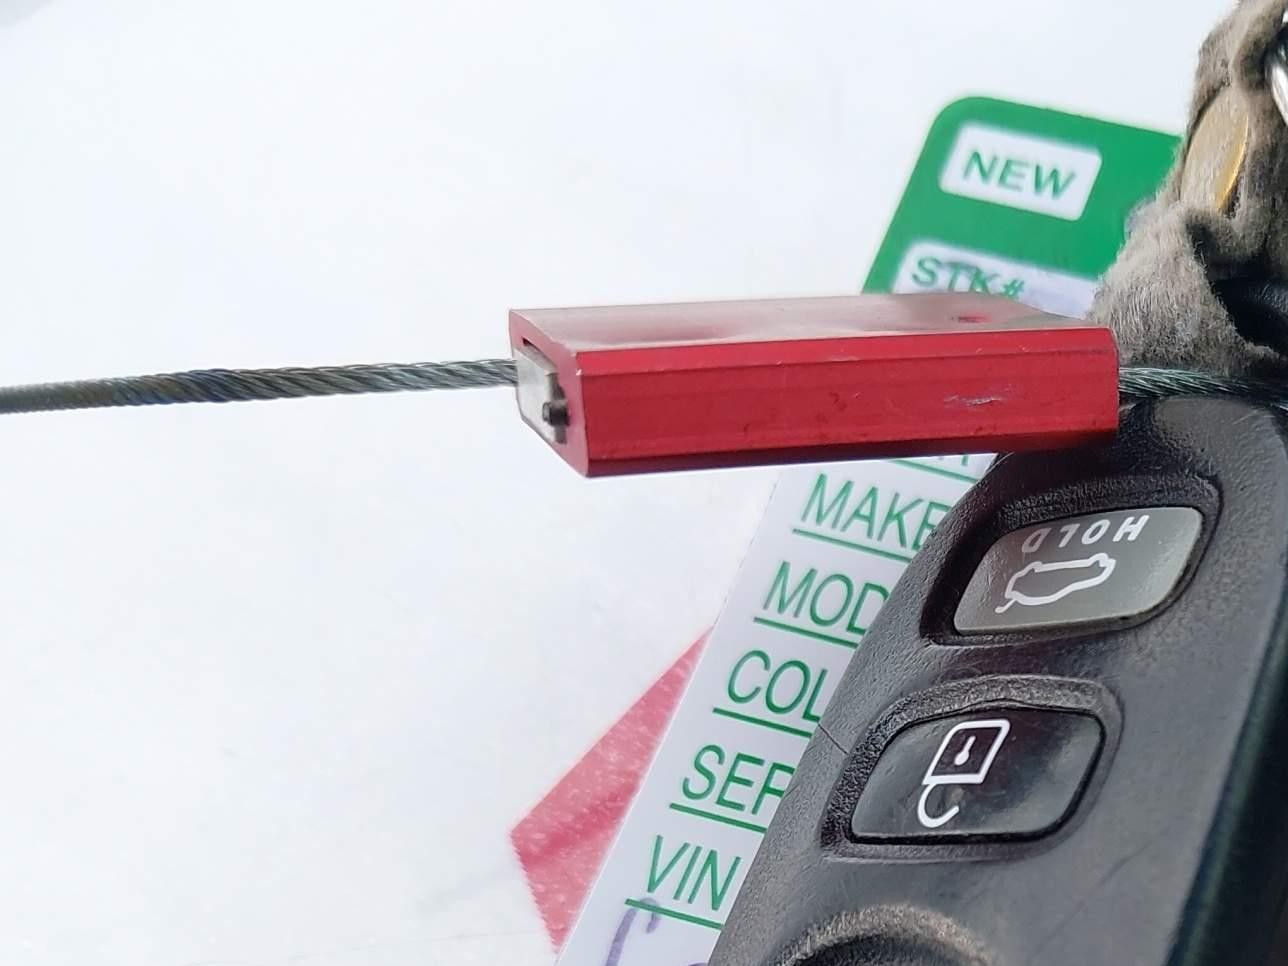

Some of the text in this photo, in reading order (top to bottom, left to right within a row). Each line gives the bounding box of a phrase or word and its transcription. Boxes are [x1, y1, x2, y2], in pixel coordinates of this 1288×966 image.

[962, 149, 1076, 198] NEW
[912, 256, 1026, 299] STK#
[1021, 514, 1150, 553] HOLD
[646, 834, 742, 911] VIN
